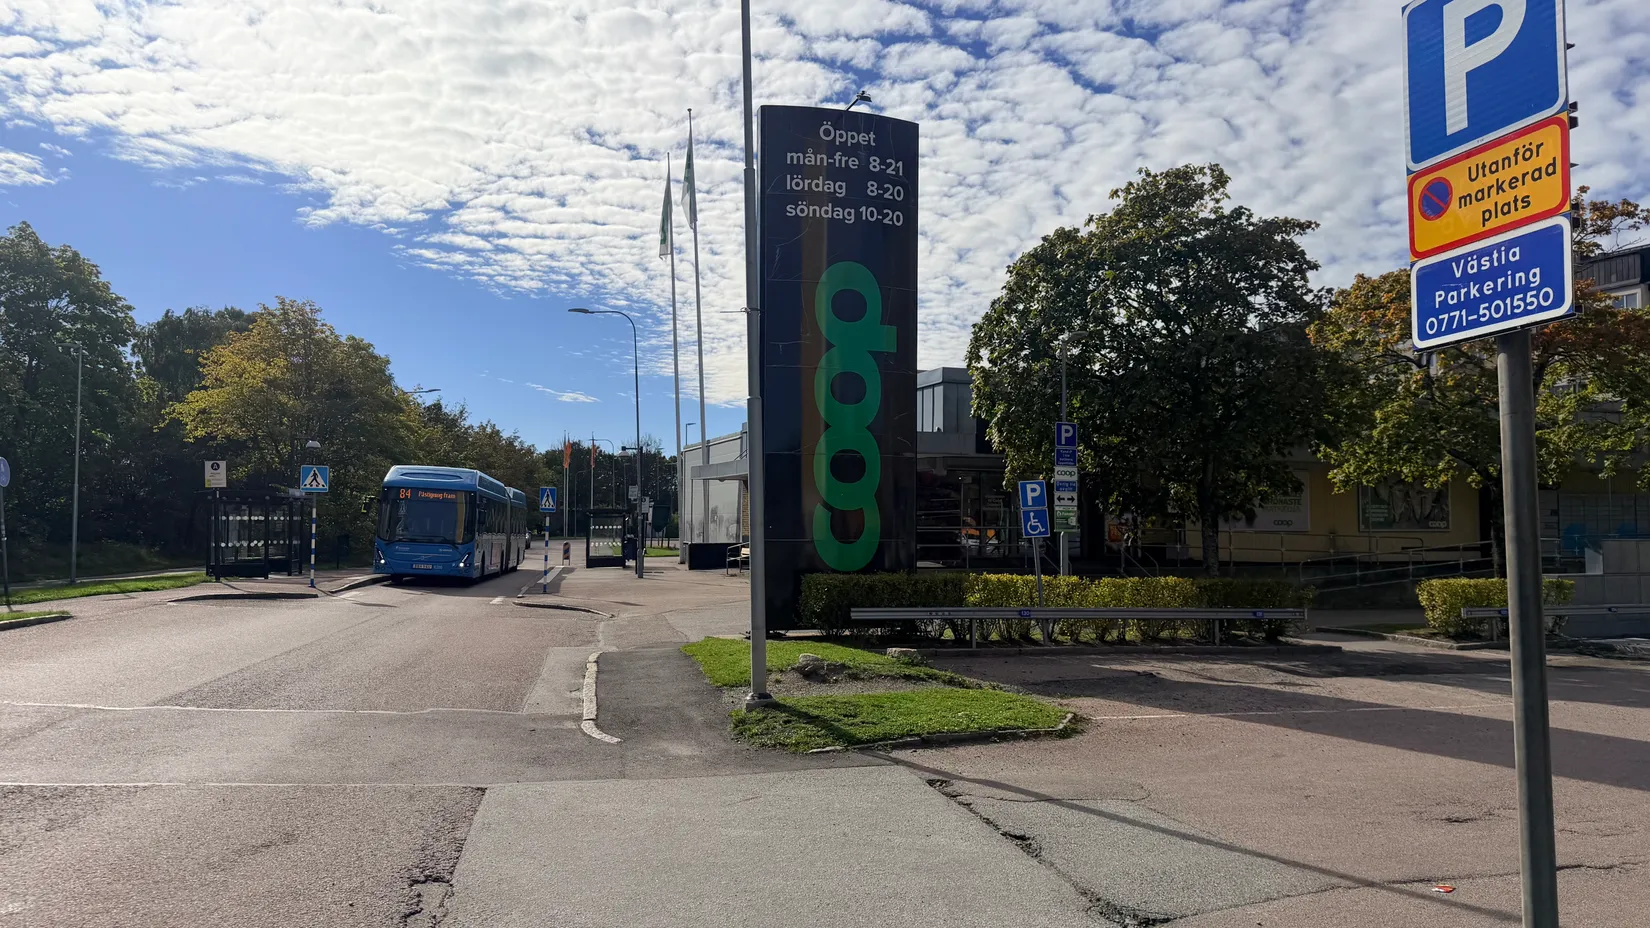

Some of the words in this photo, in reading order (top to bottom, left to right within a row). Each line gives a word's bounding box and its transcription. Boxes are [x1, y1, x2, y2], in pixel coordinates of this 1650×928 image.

[1443, 0, 1526, 136] P
[819, 120, 876, 147] Öppet
[786, 148, 859, 169] mån-fre
[869, 156, 903, 176] 8-21
[1467, 141, 1544, 183] Utanför
[786, 174, 847, 197] lördag
[866, 181, 904, 201] 8-20
[1458, 157, 1557, 209] markerad
[785, 201, 855, 224] söndag
[859, 205, 904, 226] 10-20
[1481, 194, 1531, 227] plats
[1452, 246, 1520, 279] Västia
[1435, 266, 1541, 308] Parkering
[1425, 287, 1554, 335] 0771-501550
[813, 261, 897, 572] coop
[1061, 425, 1073, 445] P
[400, 488, 411, 499] 84
[1026, 483, 1041, 506] P
[1273, 519, 1293, 527] coop
[1428, 520, 1448, 528] coop
